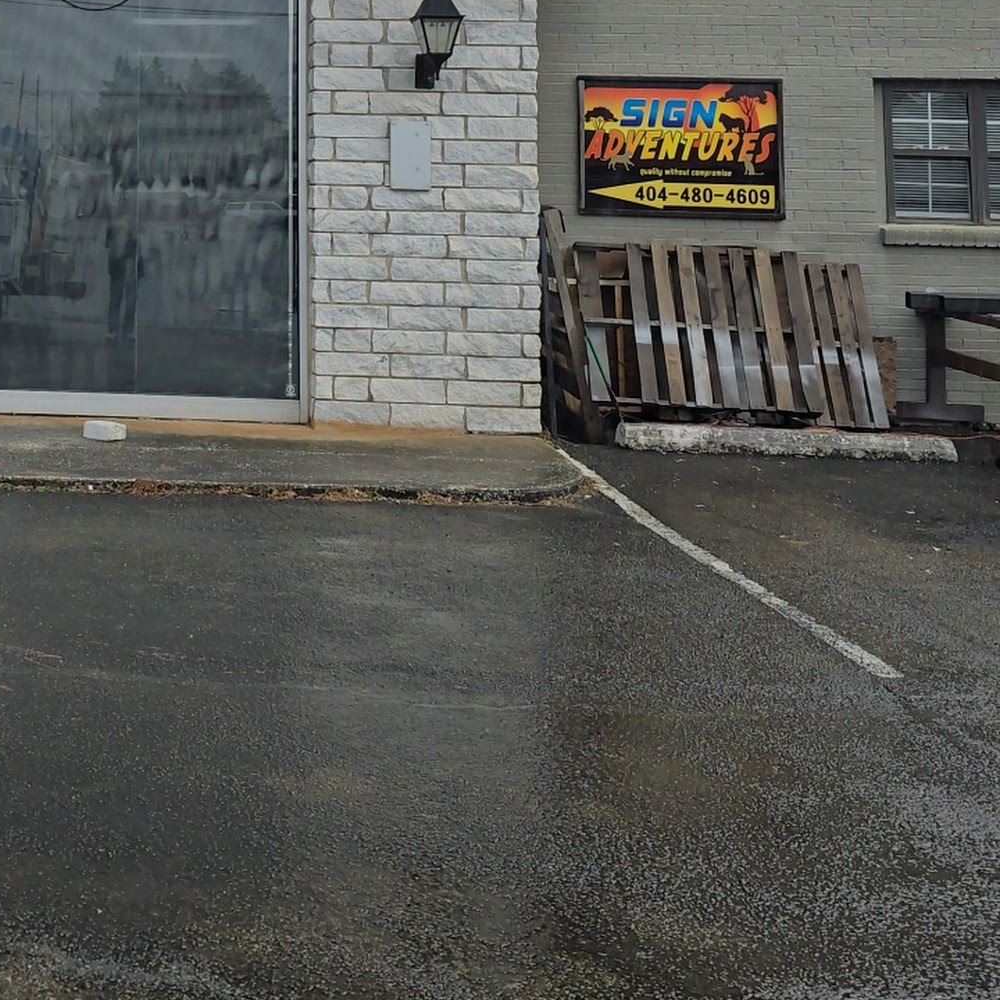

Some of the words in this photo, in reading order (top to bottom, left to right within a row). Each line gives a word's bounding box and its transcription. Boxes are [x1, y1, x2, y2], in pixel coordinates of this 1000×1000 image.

[619, 97, 718, 129] SIGN
[584, 129, 776, 164] ADVENTURES
[640, 167, 663, 178] quality
[665, 168, 690, 177] without
[691, 168, 733, 178] compromise
[635, 186, 770, 205] 404-480-4609
